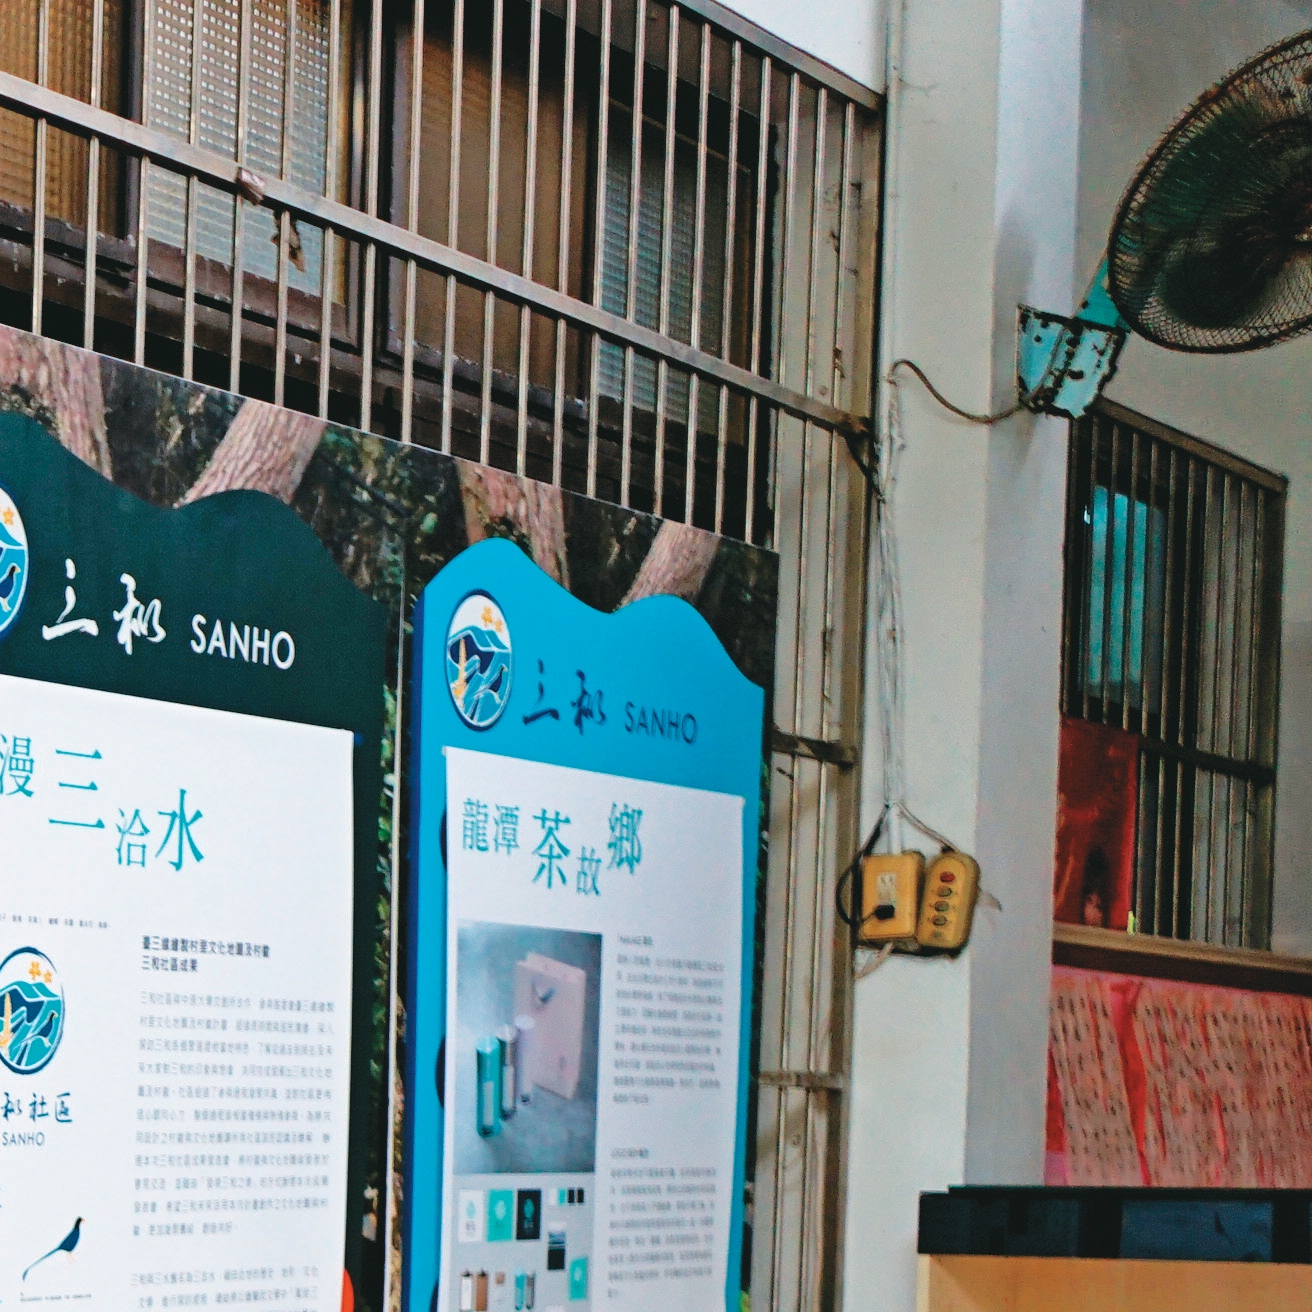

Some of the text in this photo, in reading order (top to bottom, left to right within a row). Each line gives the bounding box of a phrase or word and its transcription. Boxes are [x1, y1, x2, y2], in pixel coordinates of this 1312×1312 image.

[190, 613, 295, 670] SANHO
[625, 702, 698, 745] SANHO
[462, 797, 644, 896] 龍潭茶故鄉
[1, 1131, 45, 1146] SANHO
